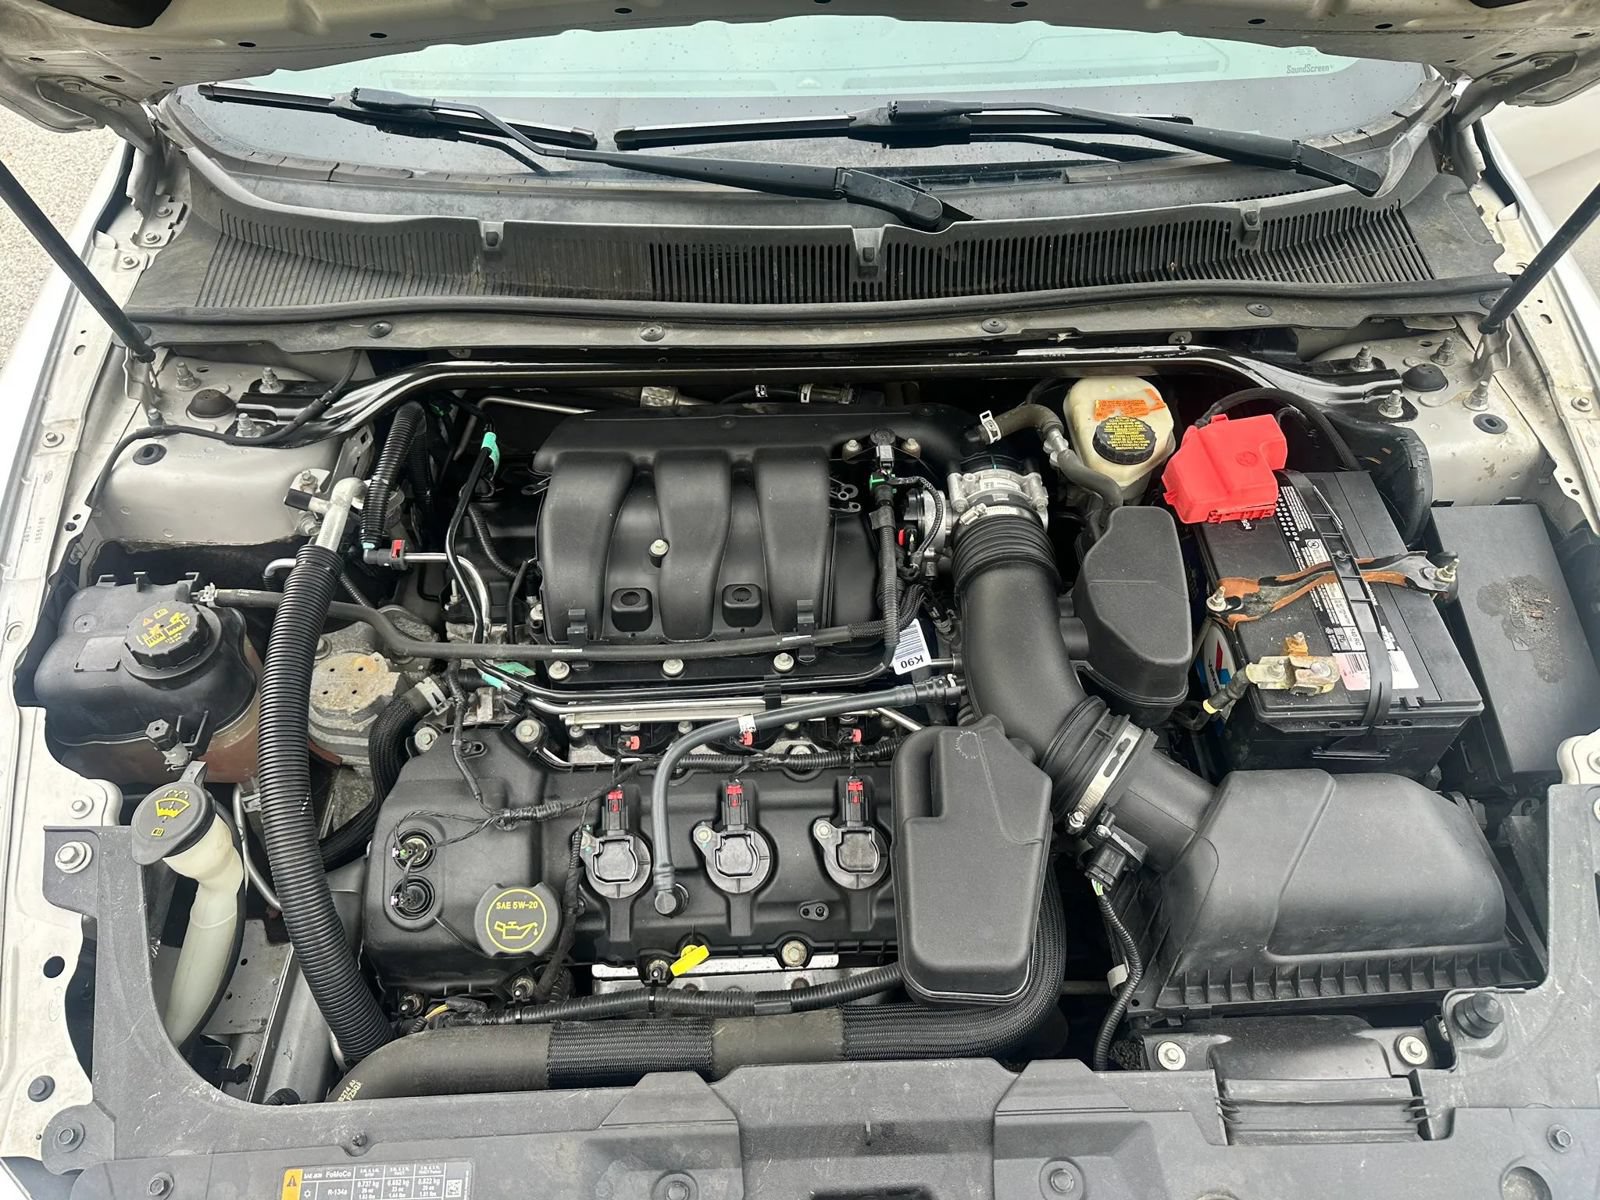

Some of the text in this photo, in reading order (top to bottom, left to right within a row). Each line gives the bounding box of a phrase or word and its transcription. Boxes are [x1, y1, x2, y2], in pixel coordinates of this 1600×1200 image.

[1286, 63, 1330, 74] SoundScreen
[900, 654, 924, 669] K90
[496, 900, 539, 910] SAE 5W-20
[325, 1170, 352, 1178] FoMoCo
